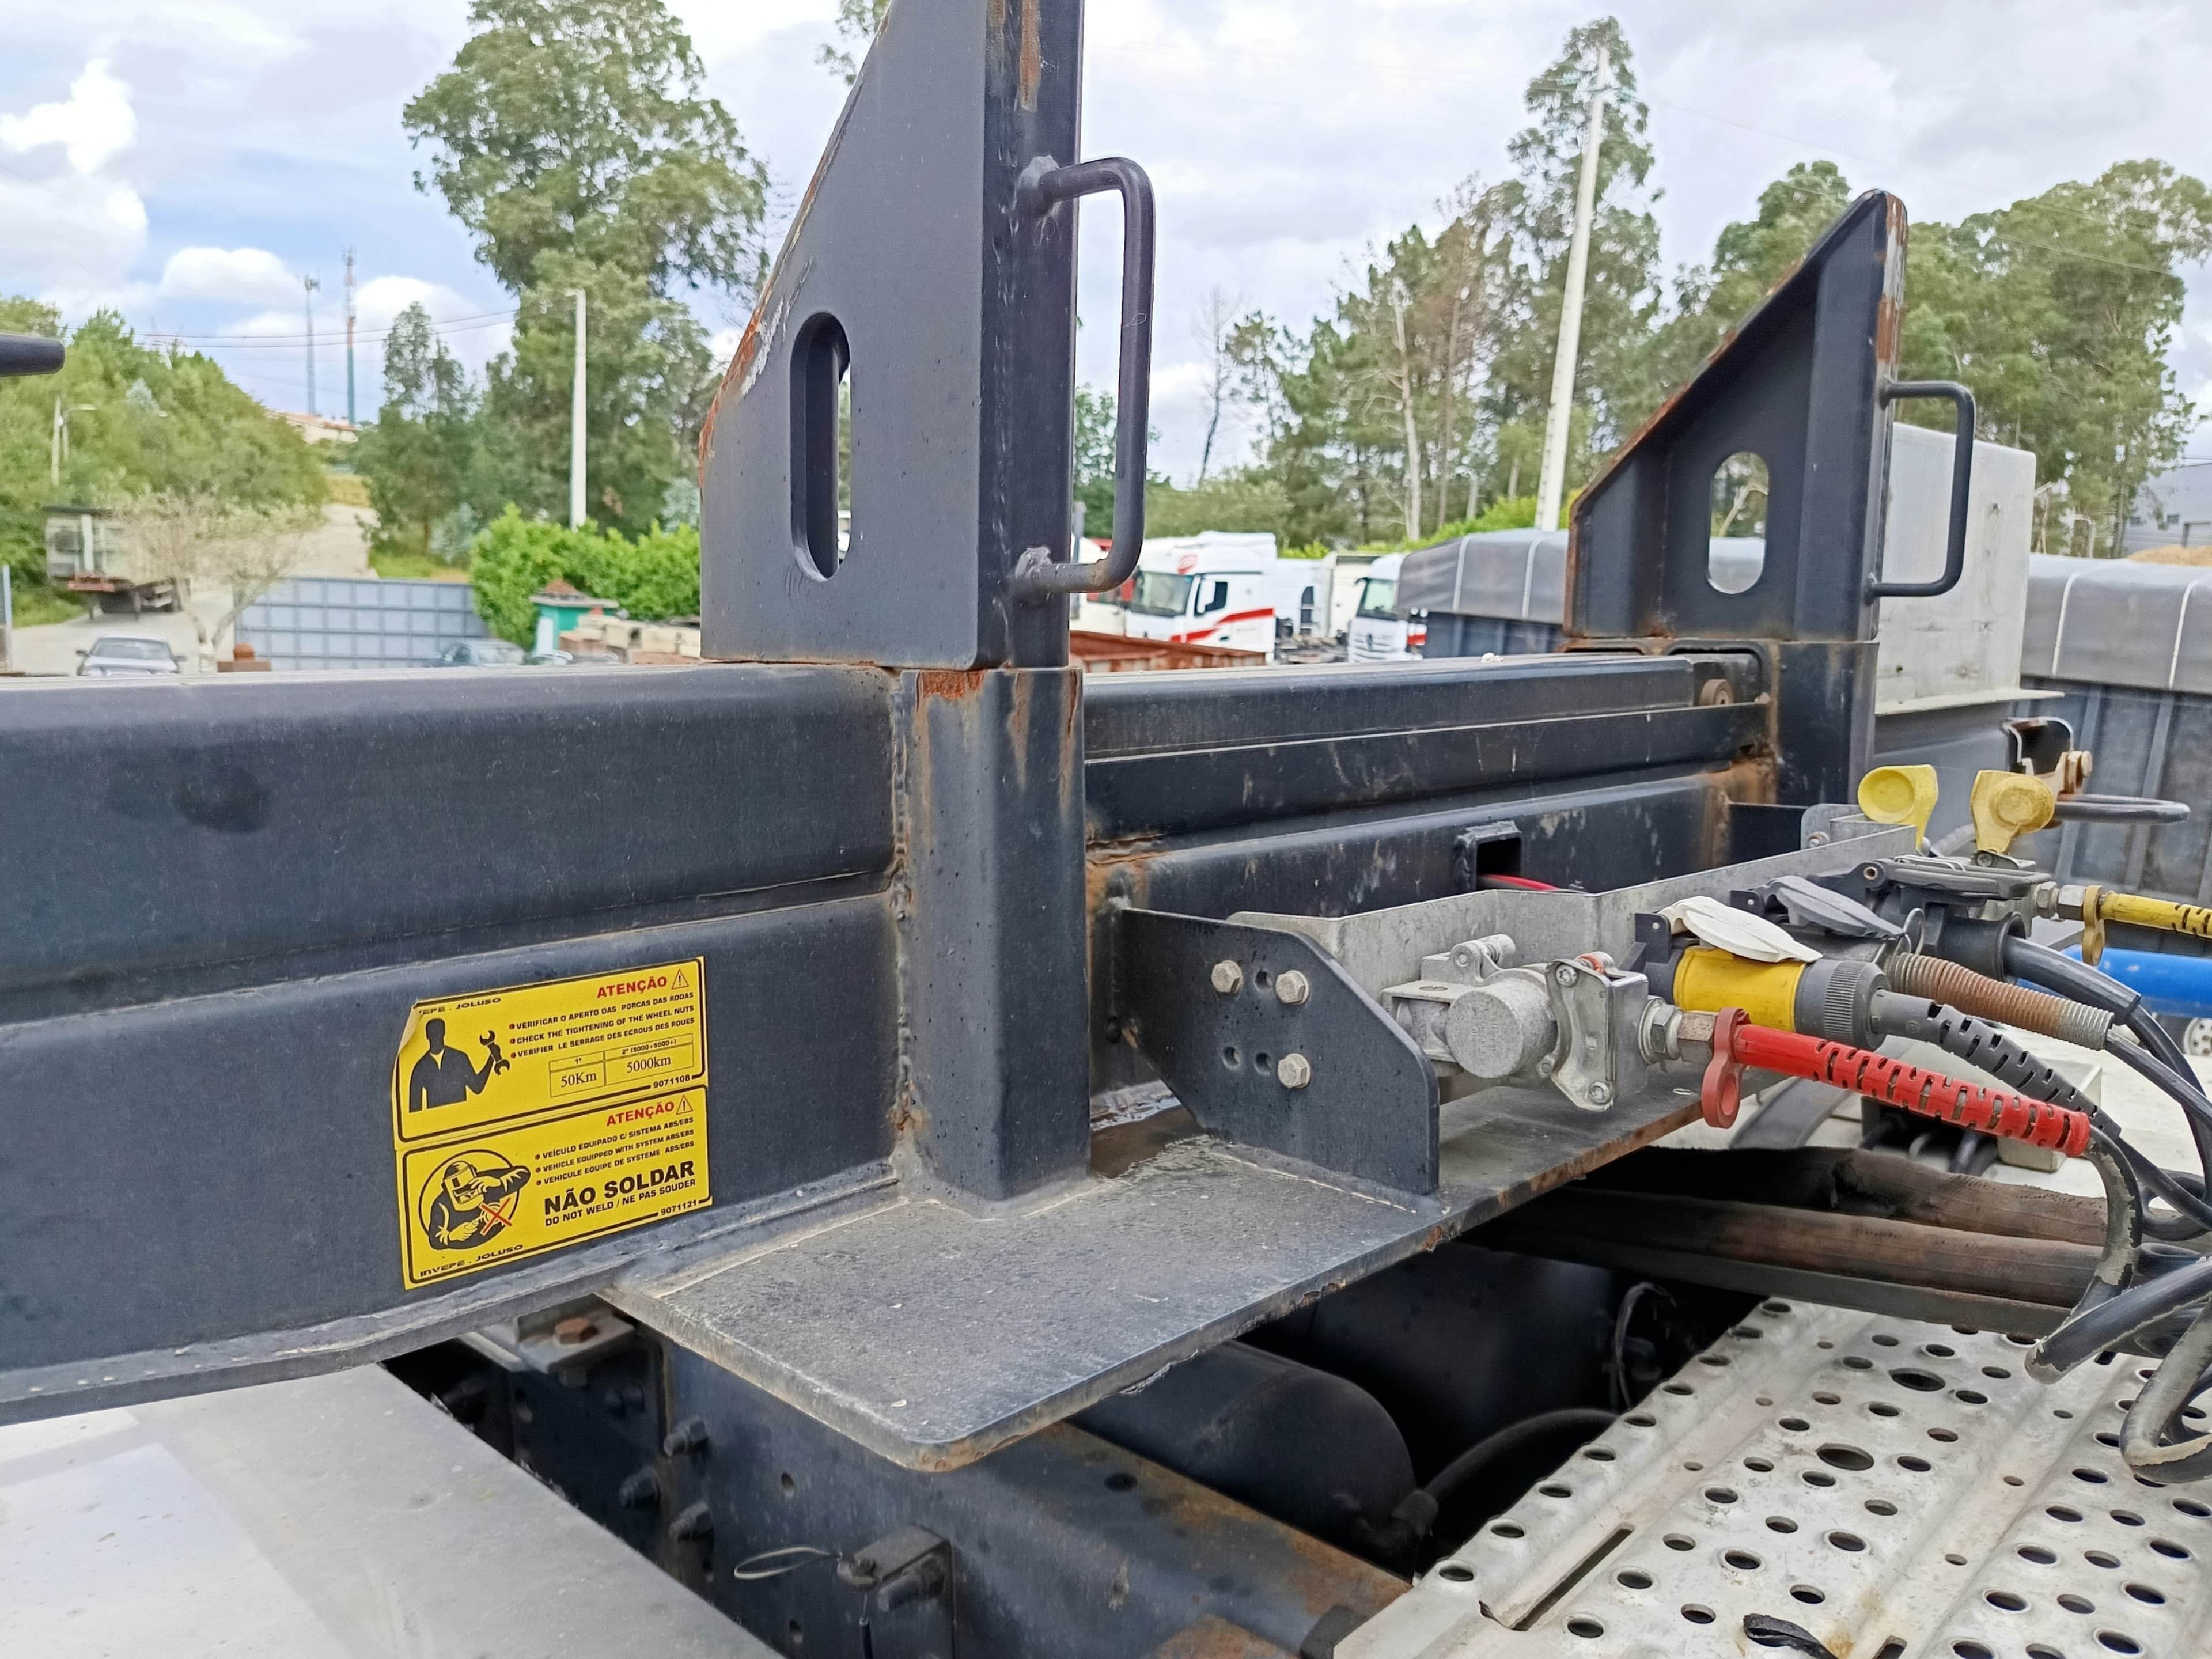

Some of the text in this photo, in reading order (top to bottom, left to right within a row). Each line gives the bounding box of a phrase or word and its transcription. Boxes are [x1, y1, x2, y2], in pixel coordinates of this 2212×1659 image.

[456, 997, 501, 1010] JOLUSO
[596, 976, 668, 999] ATENÇÃO
[516, 1016, 558, 1030] VERIFICAR
[569, 1009, 599, 1021] APERTO
[601, 1006, 617, 1015] DAS
[621, 999, 651, 1011] PORCAS
[653, 997, 668, 1005] DAS
[669, 991, 694, 1002] RODAS
[517, 1005, 694, 1044] CHECK THE TIGHTENING OF THE WHEEL NUTS
[518, 1017, 695, 1058] VERIFIER LE SERRAGE DES ECROUS DES ROUES
[560, 1071, 597, 1088] 50Km
[626, 1056, 671, 1074] 5000km
[653, 1074, 691, 1089] 9071108
[606, 1101, 675, 1127] ATENÇÃO
[543, 1145, 576, 1159] VEÍCULO
[578, 1135, 618, 1150] EQUIPADO
[628, 1125, 661, 1138] SISTEMA
[664, 1116, 694, 1130] ABS/EBS
[543, 1128, 694, 1172] VEHICLE EQUIPPED WITH SYSTEM ABS/EBS
[544, 1141, 694, 1185] VEHICULE EQUIPE DE SYSTEME ABS/EBS
[544, 1160, 695, 1215] NÃO SOLDAR
[545, 1217, 559, 1226] DO
[563, 1210, 582, 1222] NOT
[586, 1201, 614, 1215] WELD
[622, 1195, 636, 1205] NE
[638, 1190, 657, 1200] PAS
[659, 1179, 696, 1195] SOUDER
[661, 1199, 697, 1215] 9071121
[476, 1244, 524, 1262] JOLUSO
